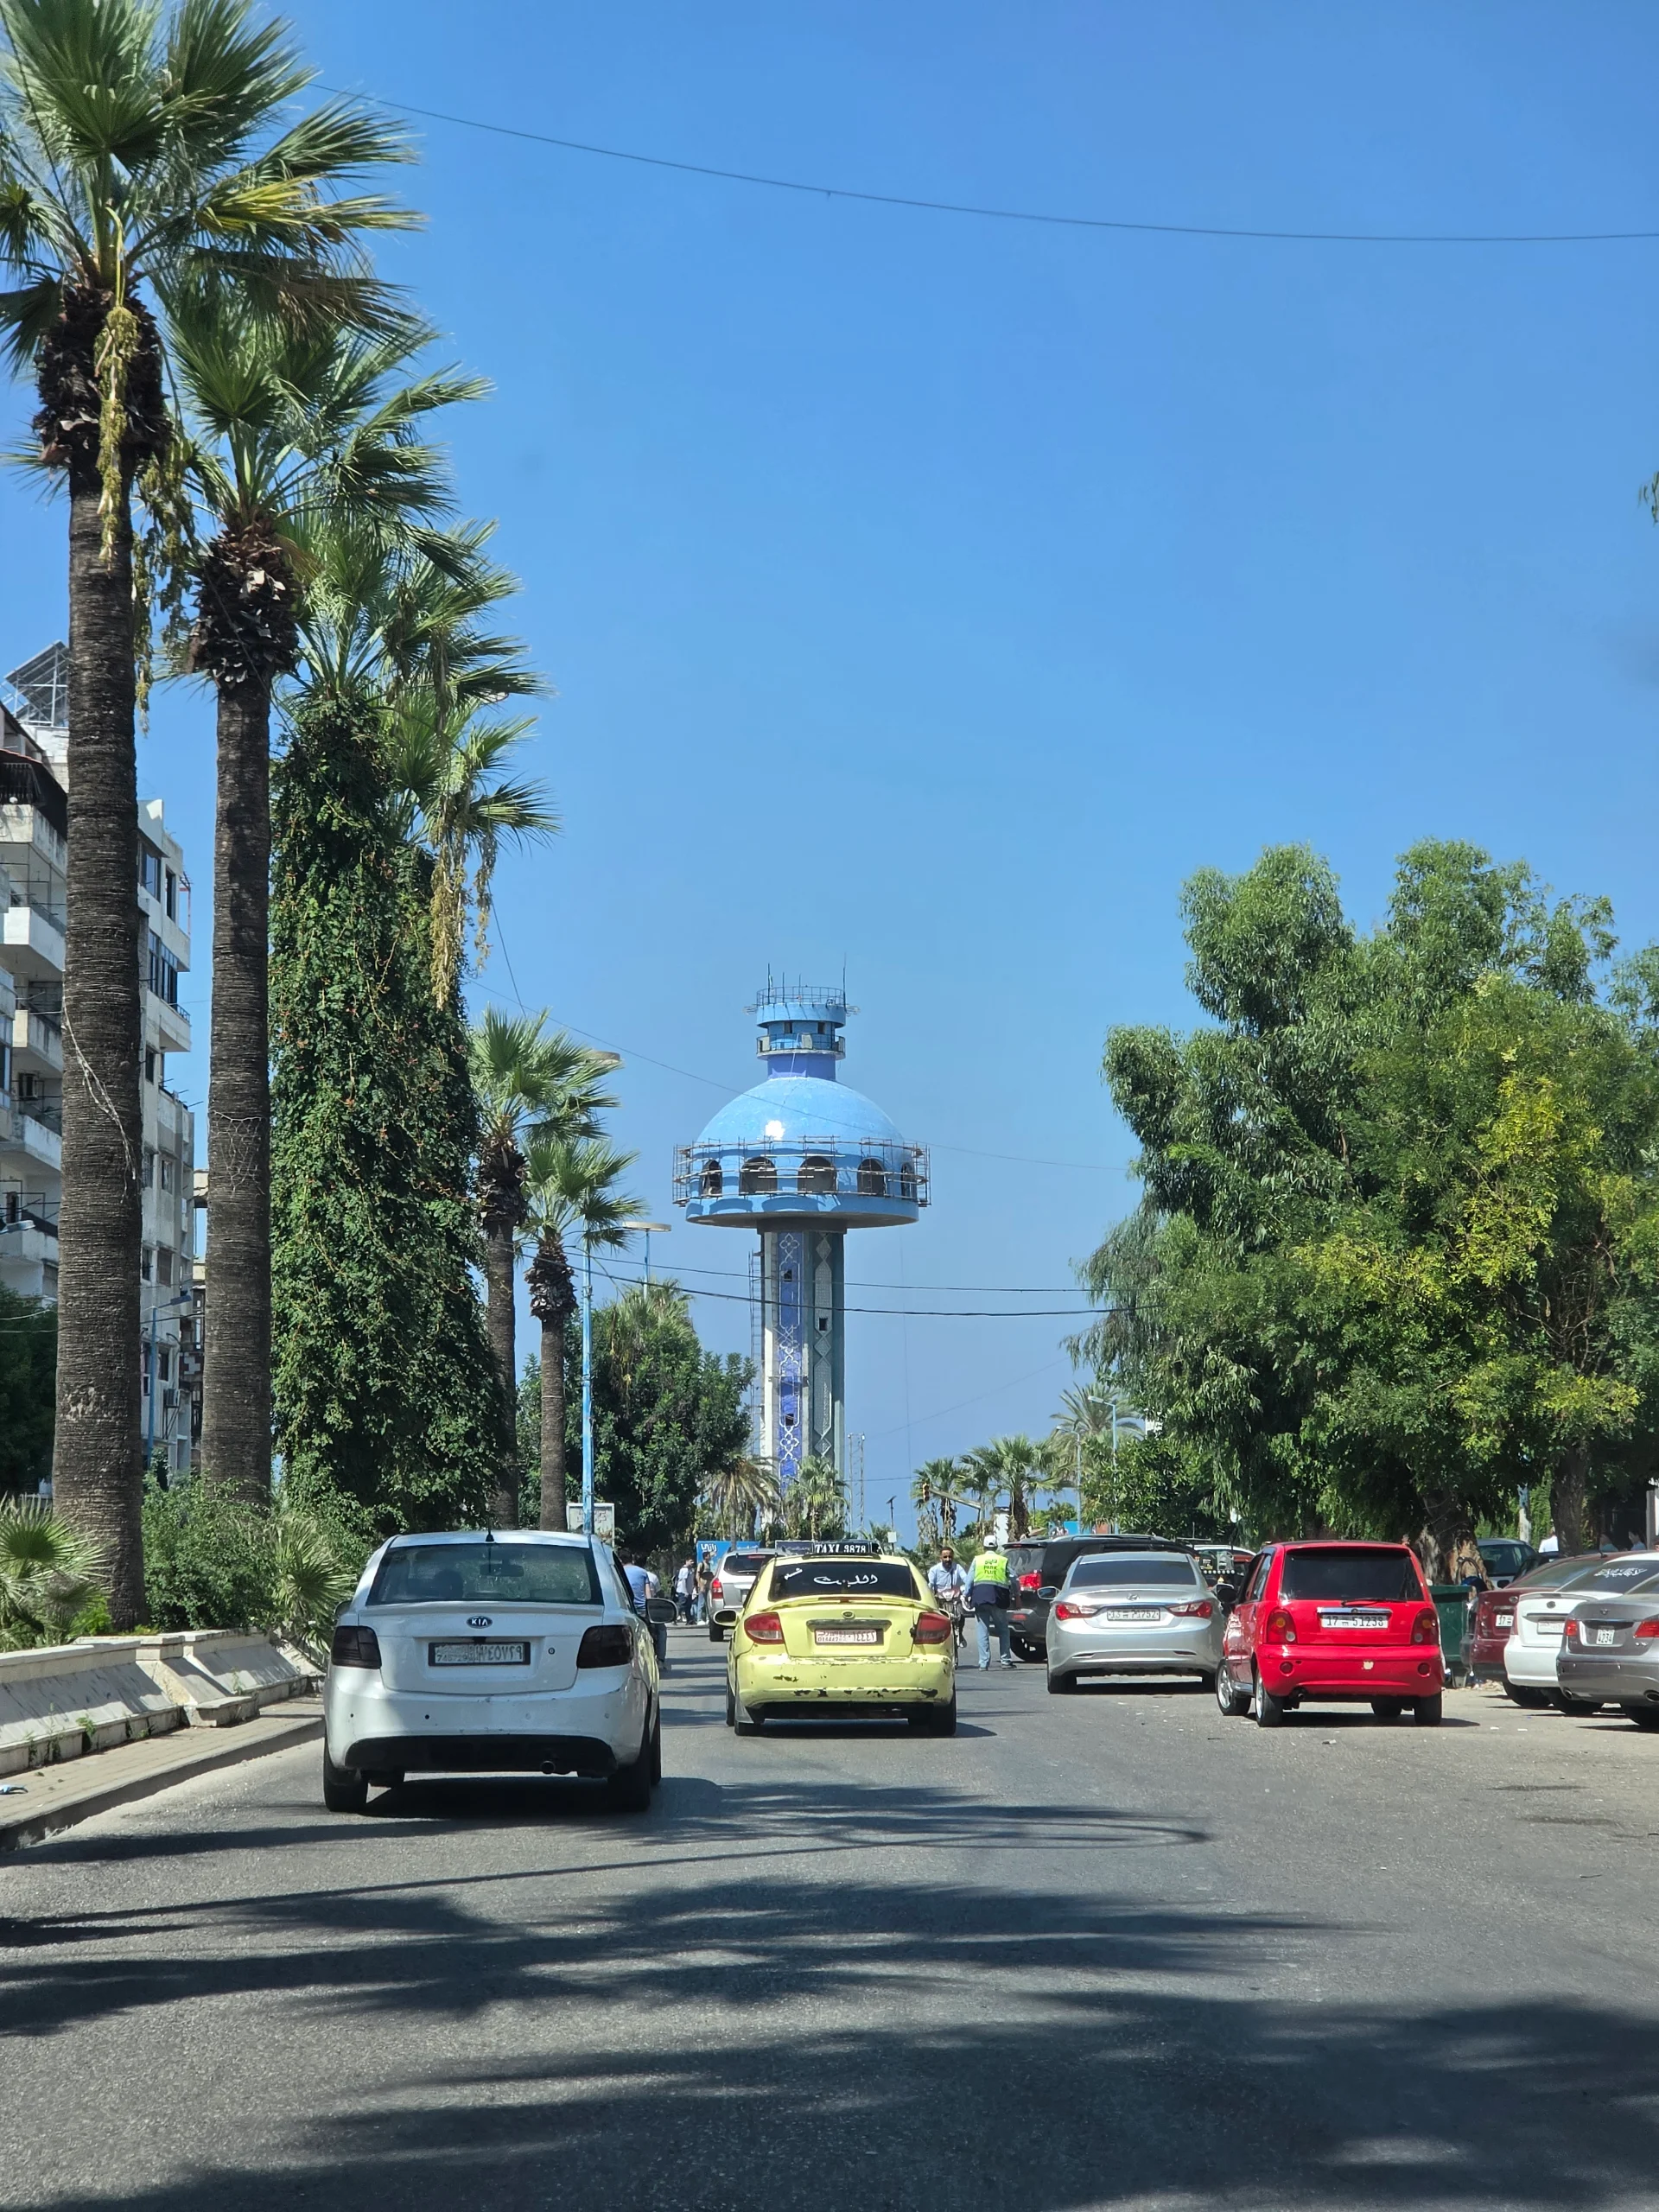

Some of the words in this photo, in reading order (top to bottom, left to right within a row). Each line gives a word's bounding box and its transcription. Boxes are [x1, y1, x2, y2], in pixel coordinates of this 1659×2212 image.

[815, 1544, 840, 1554] TAXI
[1326, 1616, 1338, 1626] 17
[1352, 1616, 1384, 1627] 51238
